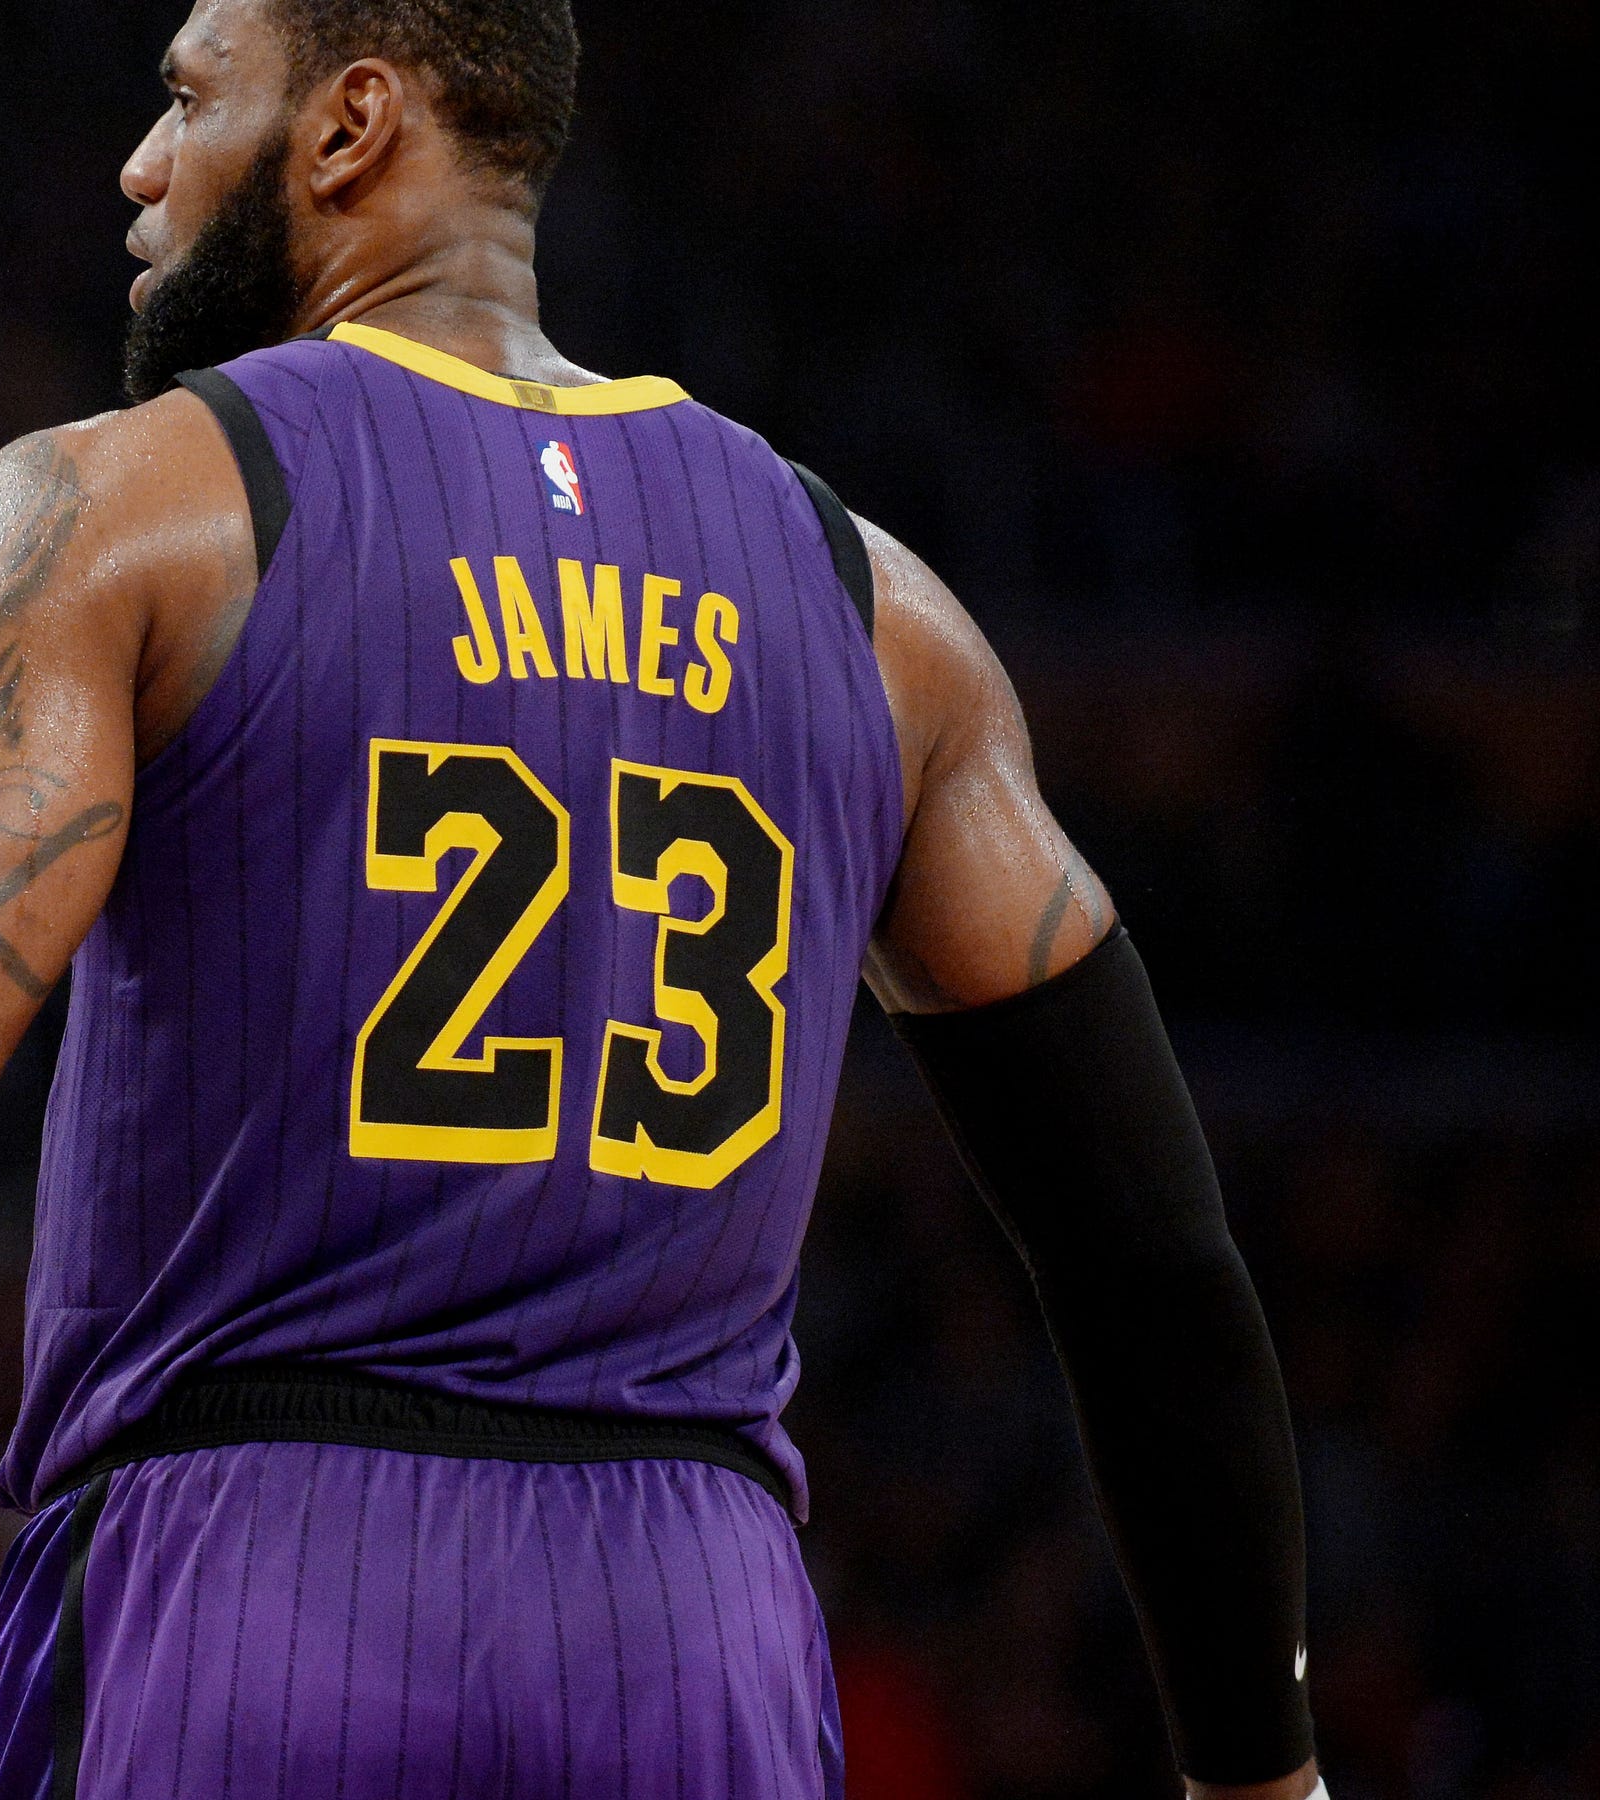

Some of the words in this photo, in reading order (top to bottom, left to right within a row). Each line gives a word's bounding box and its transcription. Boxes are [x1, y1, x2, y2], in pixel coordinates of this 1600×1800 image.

[552, 494, 573, 510] NBA
[450, 555, 740, 714] JAMES
[349, 738, 795, 1190] 23
